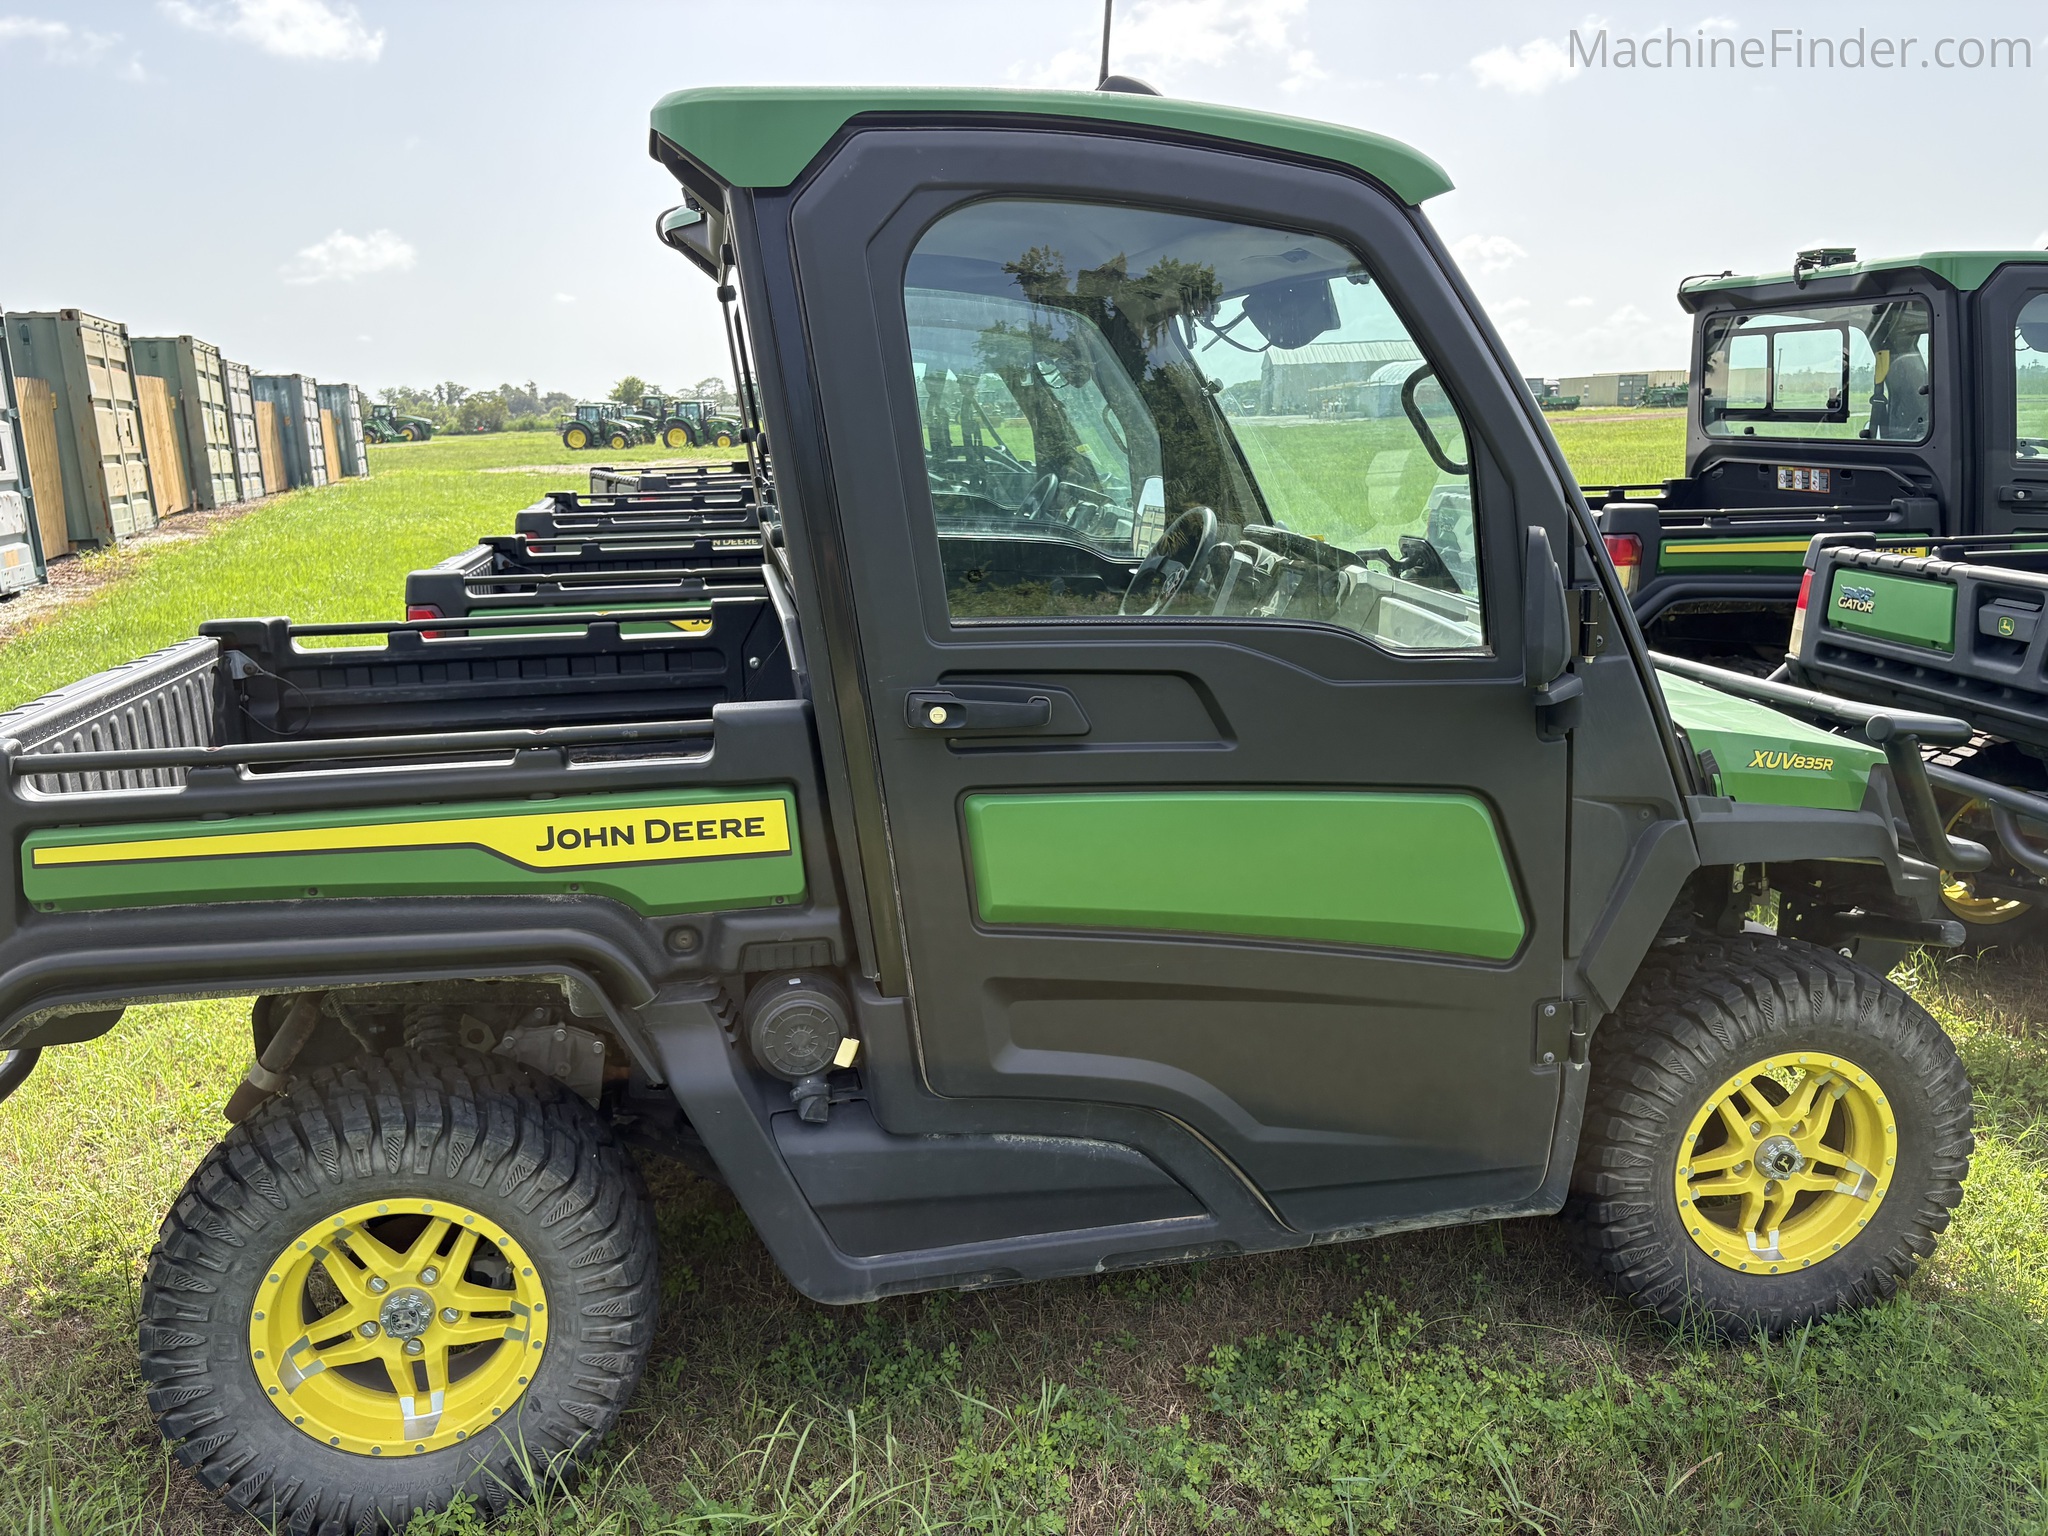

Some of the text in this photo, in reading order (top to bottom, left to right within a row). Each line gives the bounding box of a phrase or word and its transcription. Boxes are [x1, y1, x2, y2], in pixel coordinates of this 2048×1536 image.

[1837, 596, 1875, 613] GATOR
[1747, 750, 1834, 771] XUV835R
[536, 816, 765, 852] JOHN DEERE
